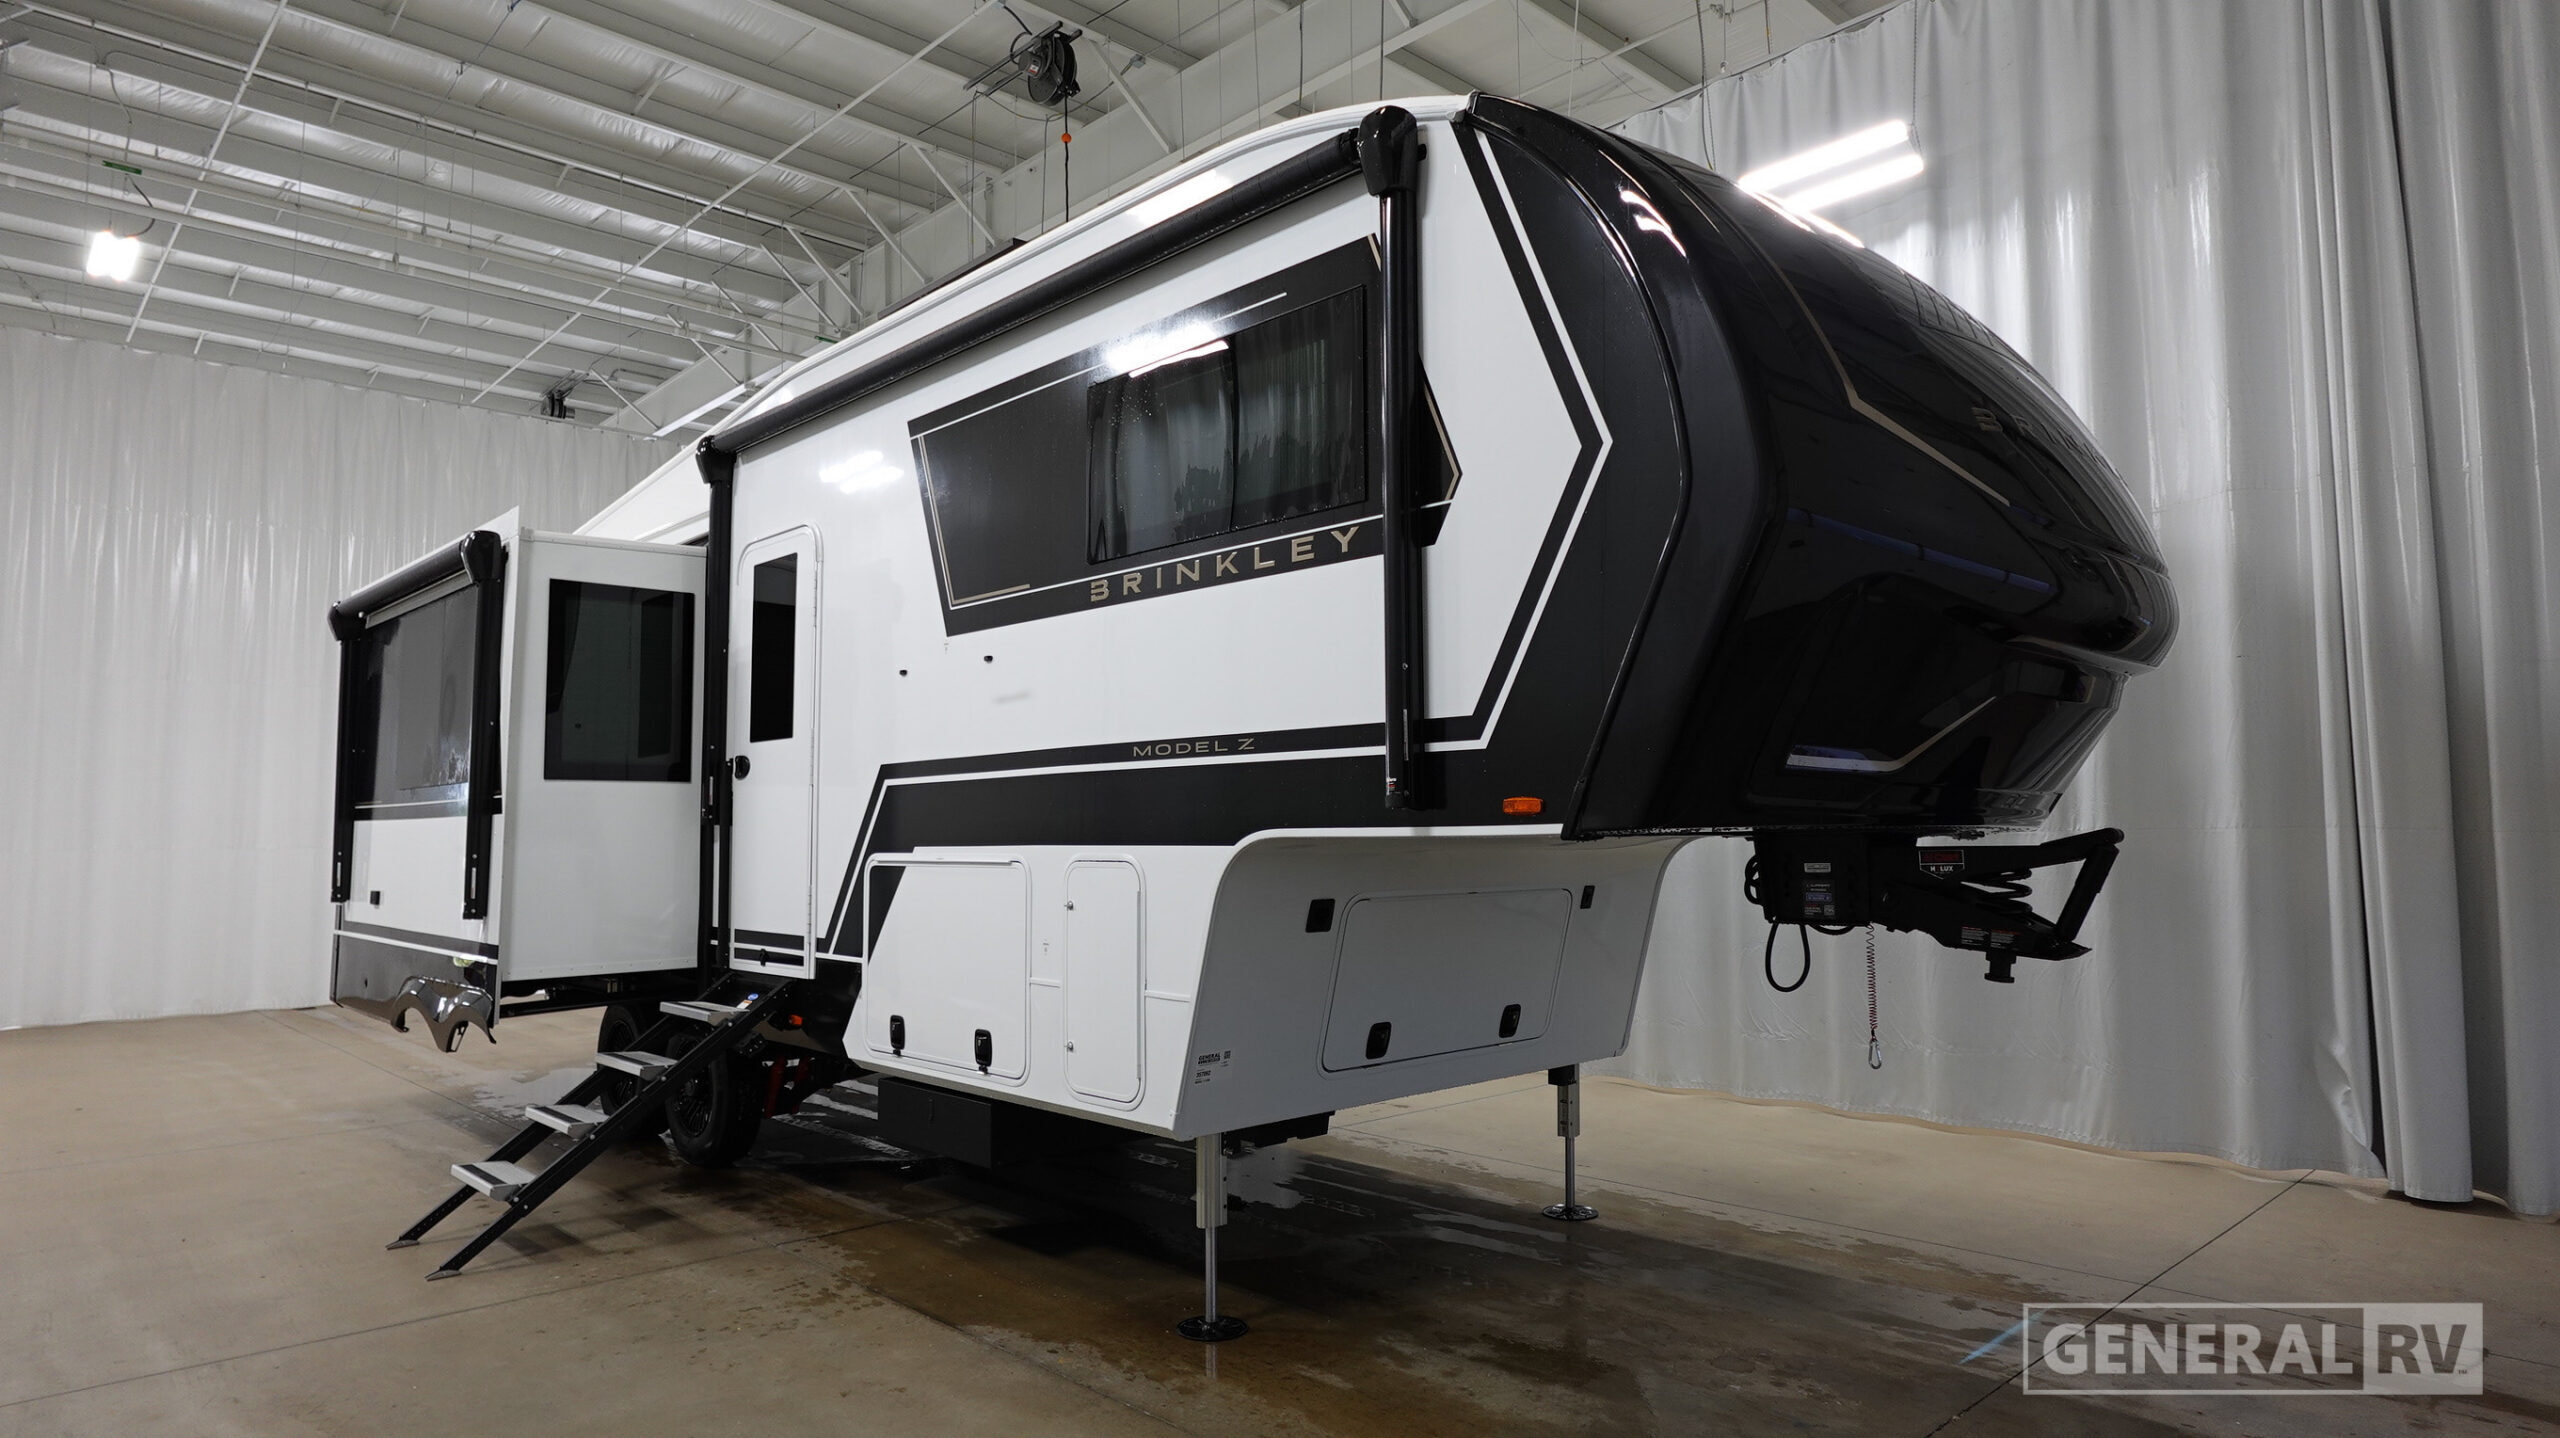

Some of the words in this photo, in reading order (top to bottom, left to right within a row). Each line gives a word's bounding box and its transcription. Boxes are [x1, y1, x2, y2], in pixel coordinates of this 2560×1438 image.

[1090, 526, 1360, 602] BRINKLEY
[1133, 740, 1229, 757] MODEL
[1238, 738, 1255, 750] Z
